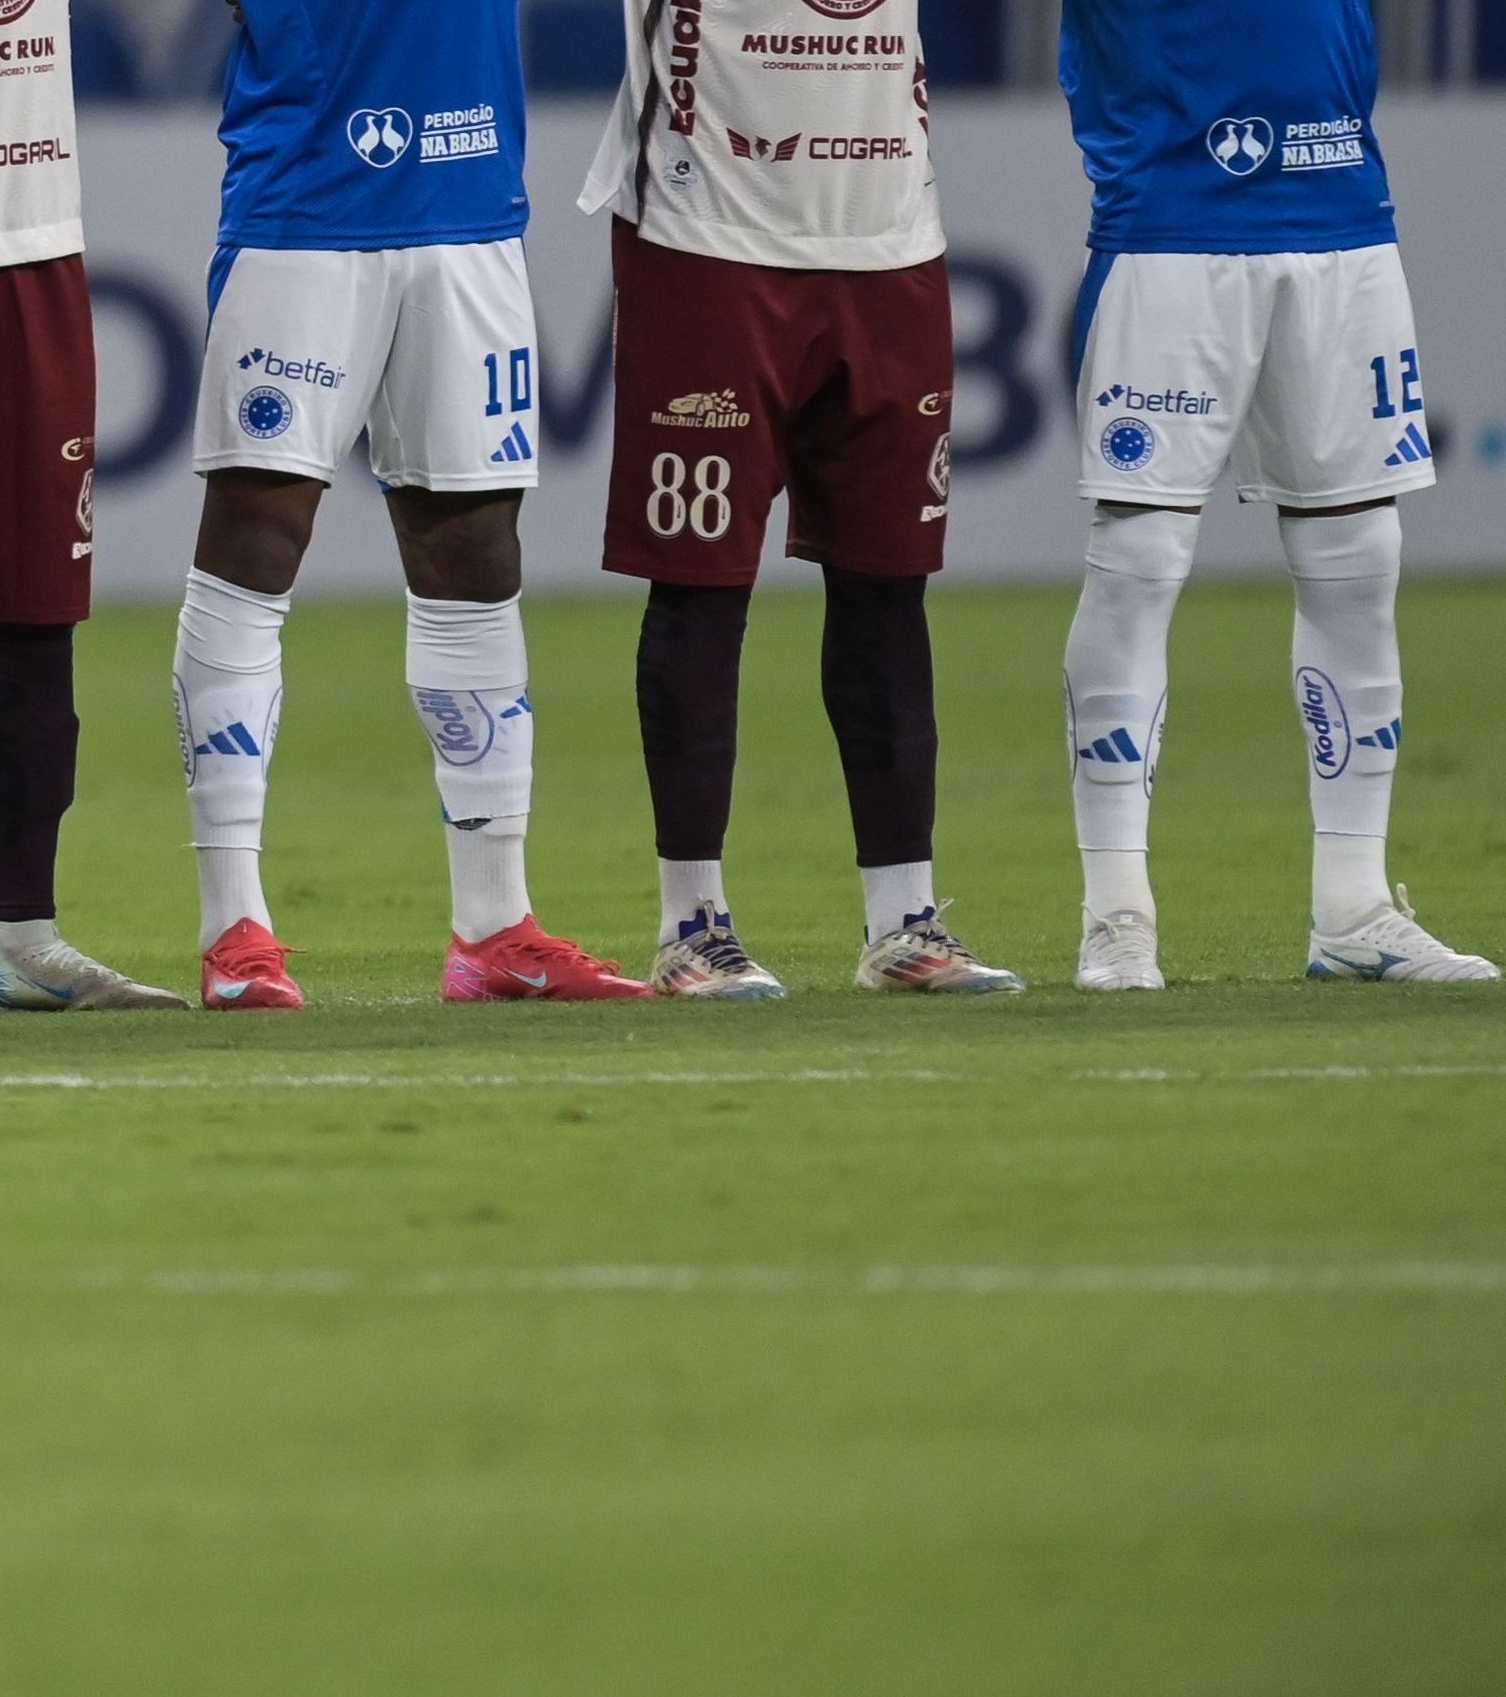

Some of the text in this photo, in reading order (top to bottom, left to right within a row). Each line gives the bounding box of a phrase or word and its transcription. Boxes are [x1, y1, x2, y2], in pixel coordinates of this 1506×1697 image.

[16, 36, 55, 59] RUN
[741, 34, 905, 55] MUSHUC RUN
[762, 61, 825, 71] COOPERATIVA
[423, 102, 494, 130] PERDIGÃO
[1285, 115, 1362, 139] PERDIGÃO
[420, 128, 499, 158] NA BRASA
[1281, 139, 1364, 166] NA BRASA
[264, 351, 346, 390] betfair
[483, 346, 532, 417] 10
[1370, 347, 1423, 420] 12
[245, 388, 288, 407] CRUZEIRO
[1125, 385, 1218, 416] betfair
[241, 407, 291, 438] ESPORTE CLUBE
[650, 410, 750, 429] MushucAuto
[1107, 419, 1151, 439] CRUZEIRO
[646, 451, 732, 542] 88
[417, 690, 478, 754] Kodil
[1300, 674, 1335, 766] Kodilar
